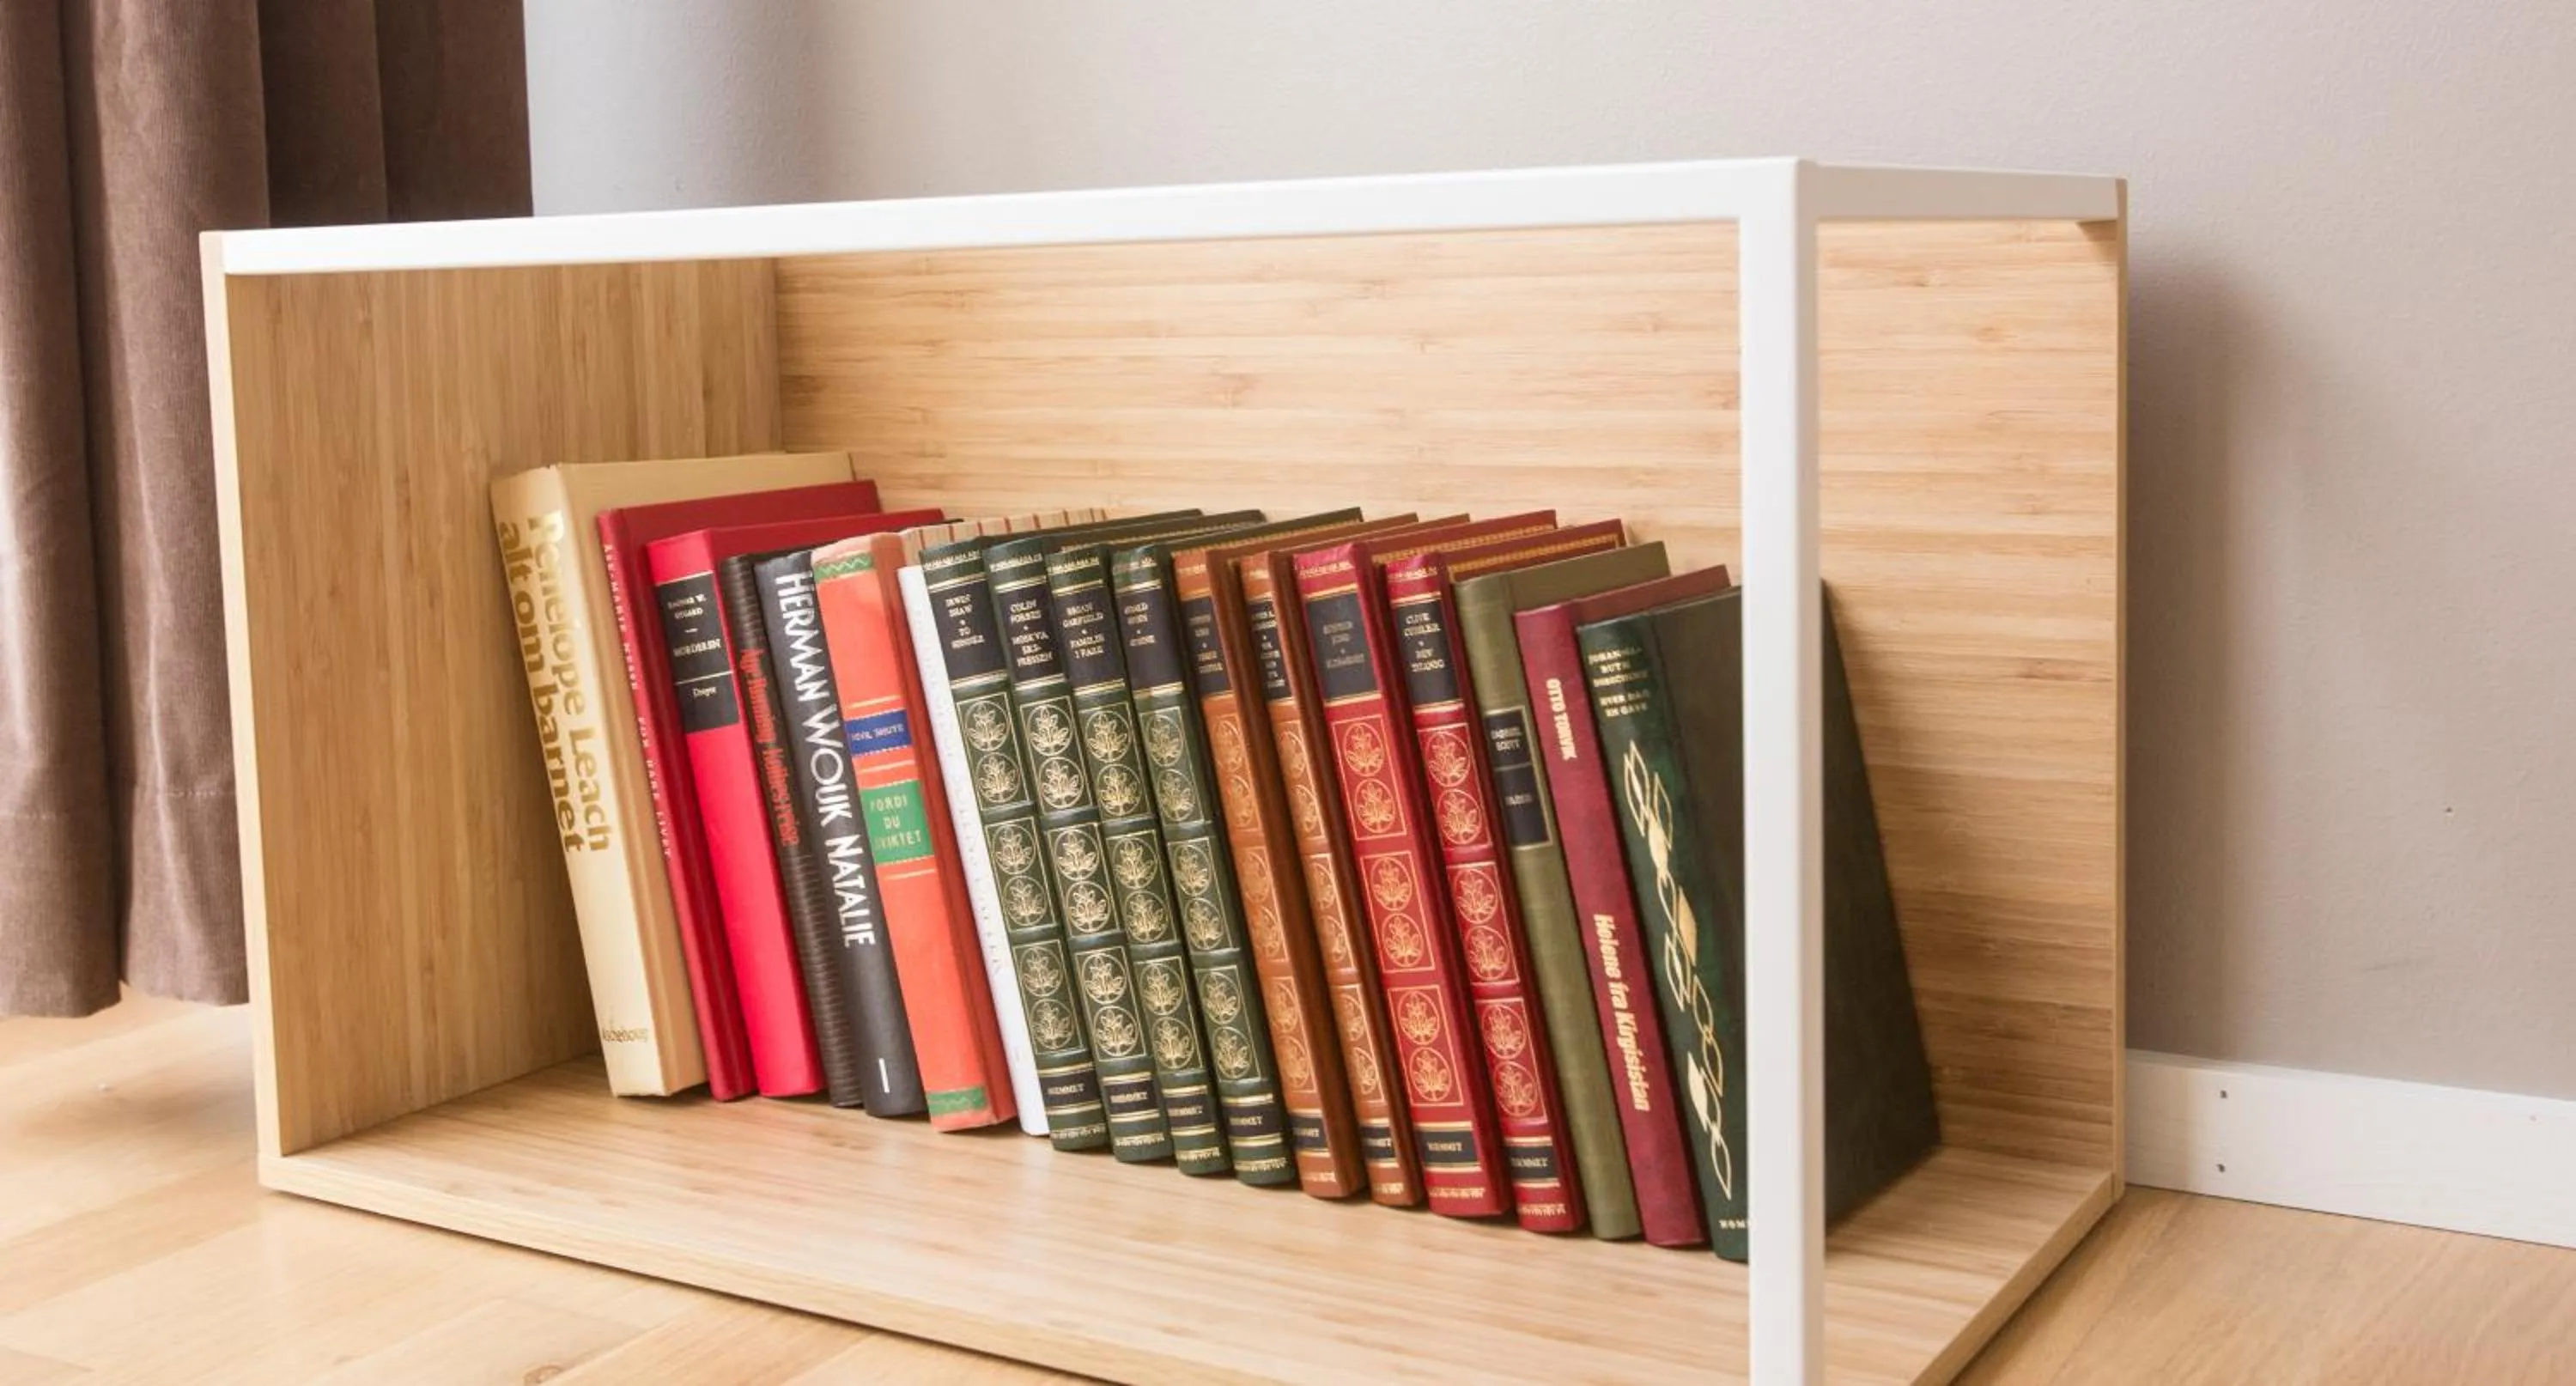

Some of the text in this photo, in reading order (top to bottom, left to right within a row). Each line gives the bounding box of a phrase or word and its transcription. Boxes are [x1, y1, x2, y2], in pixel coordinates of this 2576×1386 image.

[1010, 599, 1037, 611] COLIN
[1062, 611, 1104, 628] GARFIELD
[1405, 612, 1431, 625] CLIVE
[498, 521, 584, 853] alt om barnet
[527, 510, 612, 851] Penelope Leach
[1546, 678, 1565, 712] OTTO
[775, 570, 853, 828] HERMAN WOUK
[883, 816, 901, 830] DU
[824, 834, 876, 948] NATALIE
[1593, 914, 1623, 980] Helene
[1607, 977, 1629, 1010] fra
[1718, 1218, 1748, 1230] NOM
